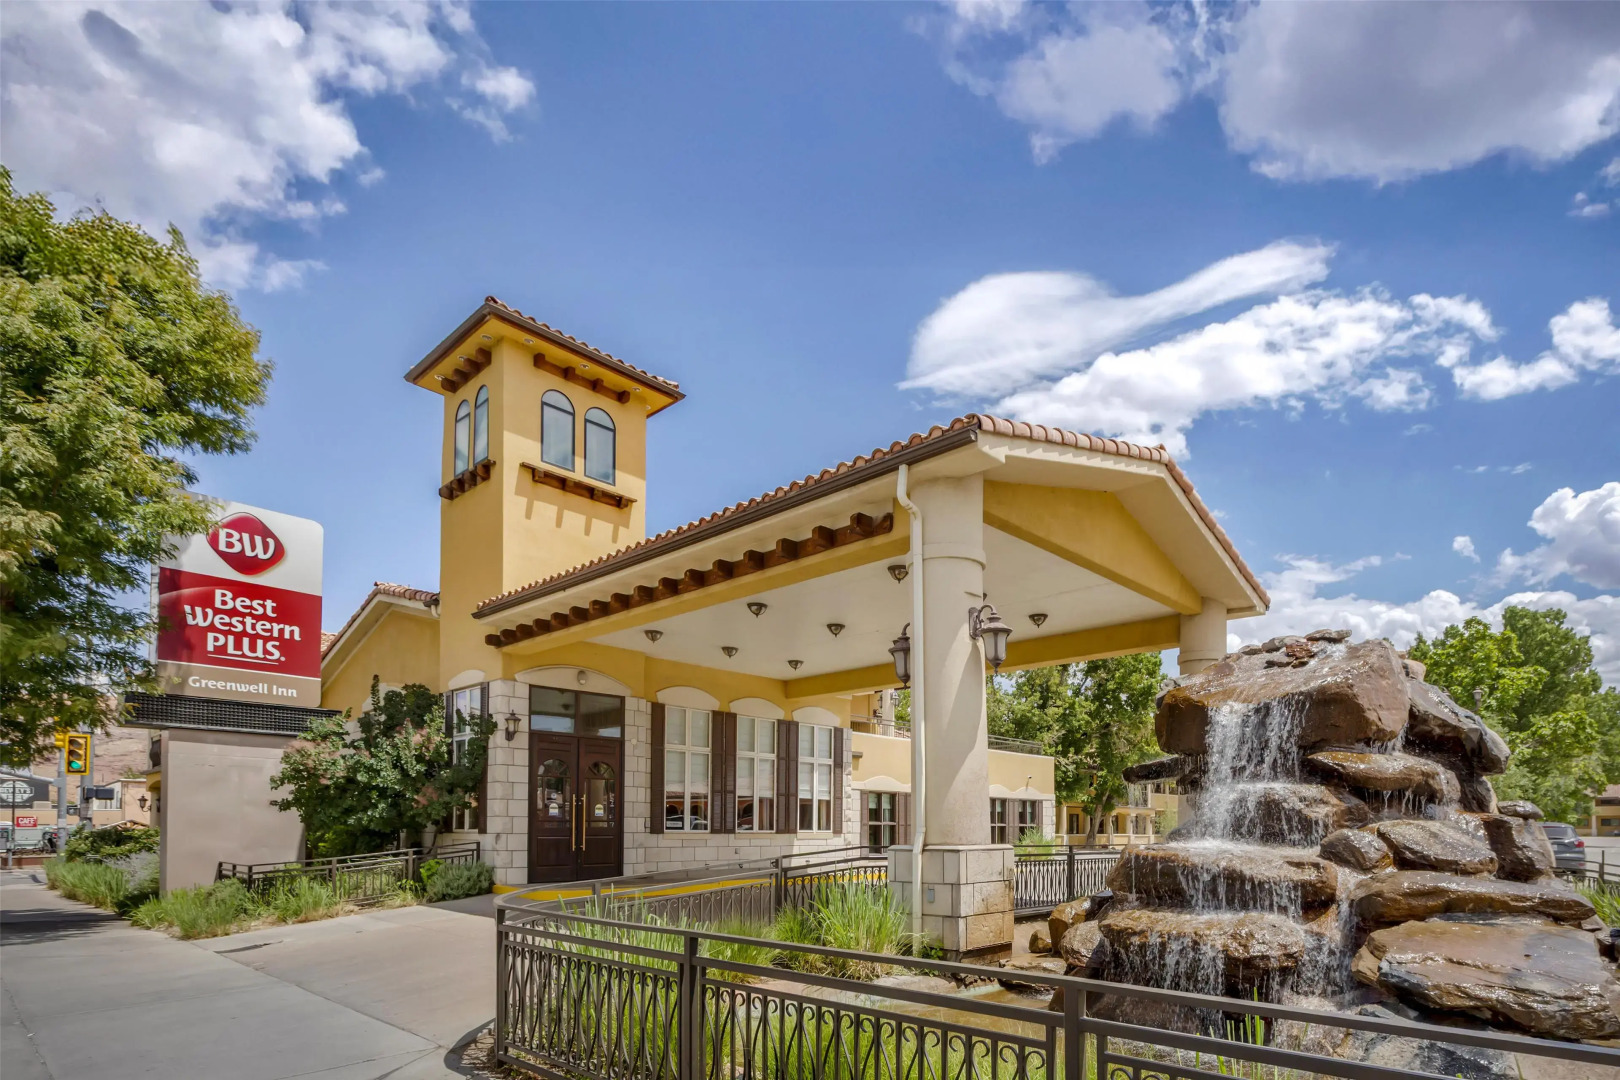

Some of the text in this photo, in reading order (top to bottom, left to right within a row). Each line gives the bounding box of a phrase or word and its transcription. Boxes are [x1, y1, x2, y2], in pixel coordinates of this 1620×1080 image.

[218, 528, 276, 560] BW
[214, 588, 278, 618] Best
[183, 604, 302, 641] Western
[187, 676, 298, 698] Greenwell Inn
